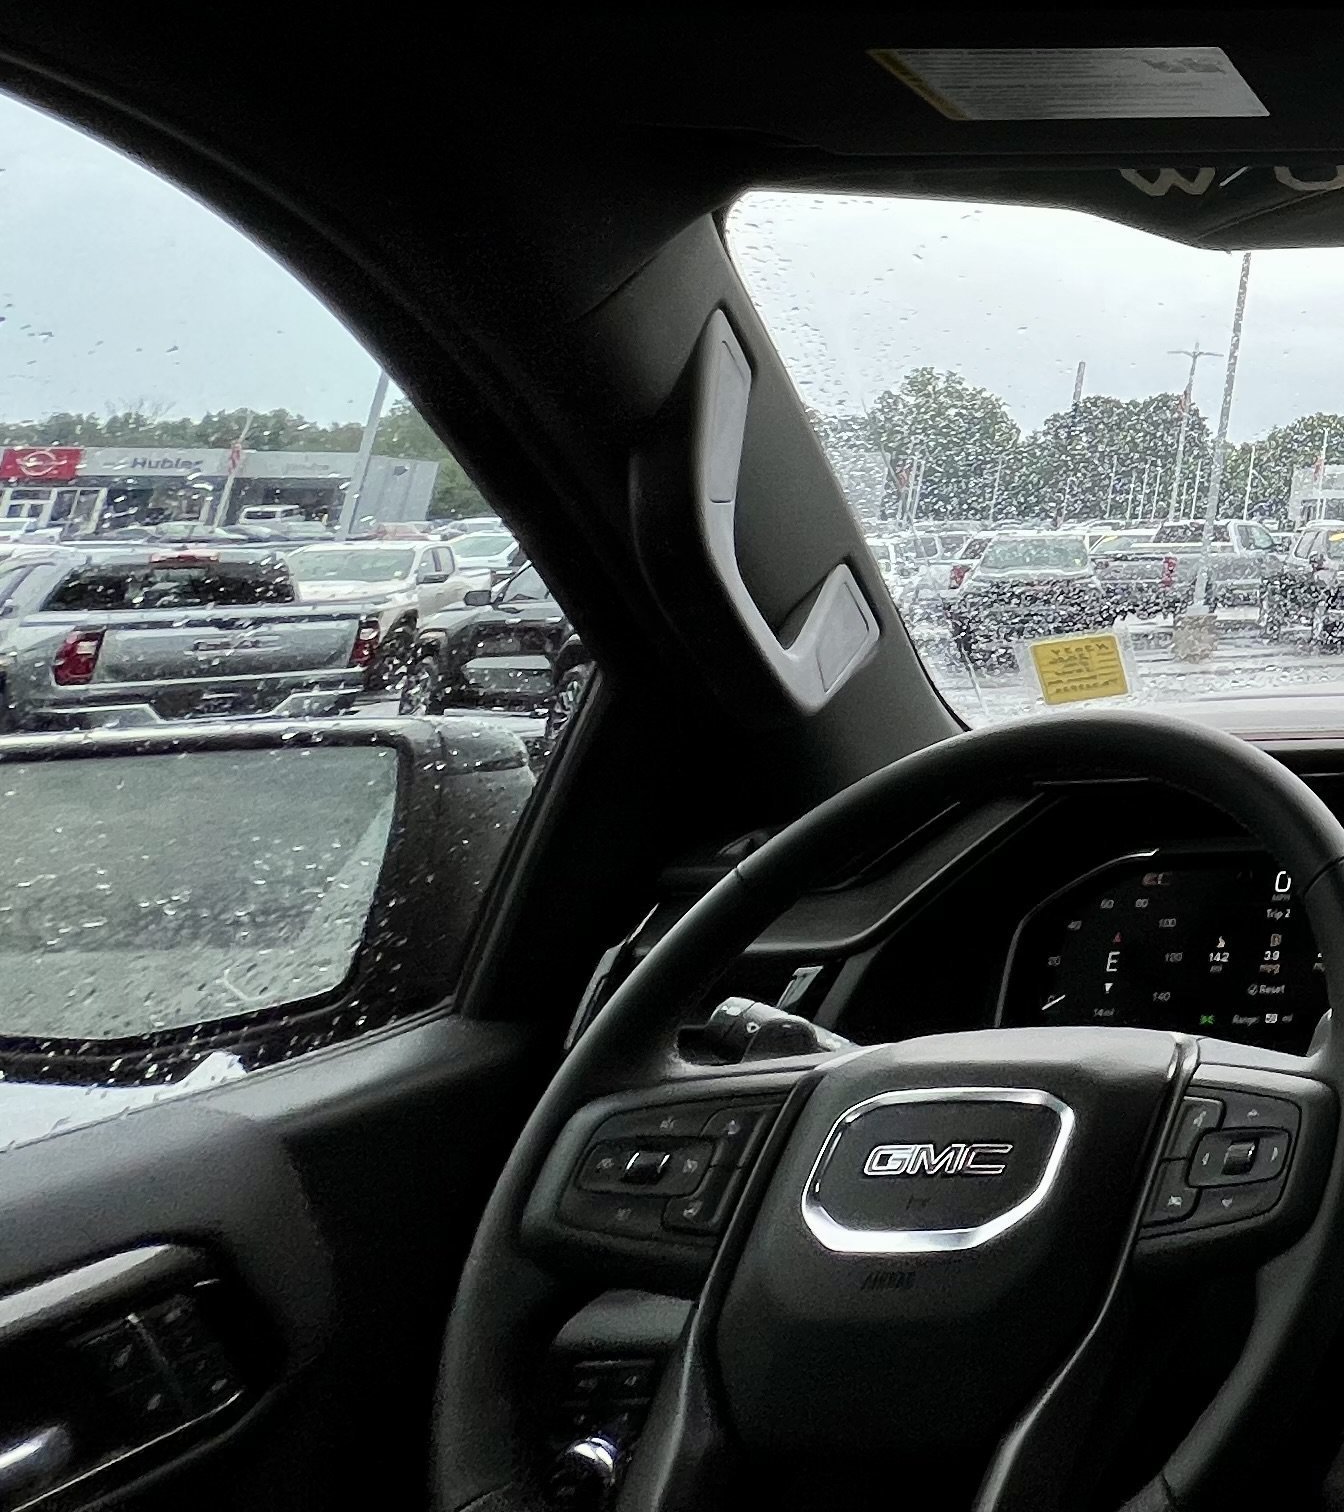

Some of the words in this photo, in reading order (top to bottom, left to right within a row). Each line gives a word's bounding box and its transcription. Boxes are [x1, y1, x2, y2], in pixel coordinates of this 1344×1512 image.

[1266, 908, 1284, 921] Trip
[1106, 951, 1121, 972] E
[863, 1143, 1014, 1177] GMC
